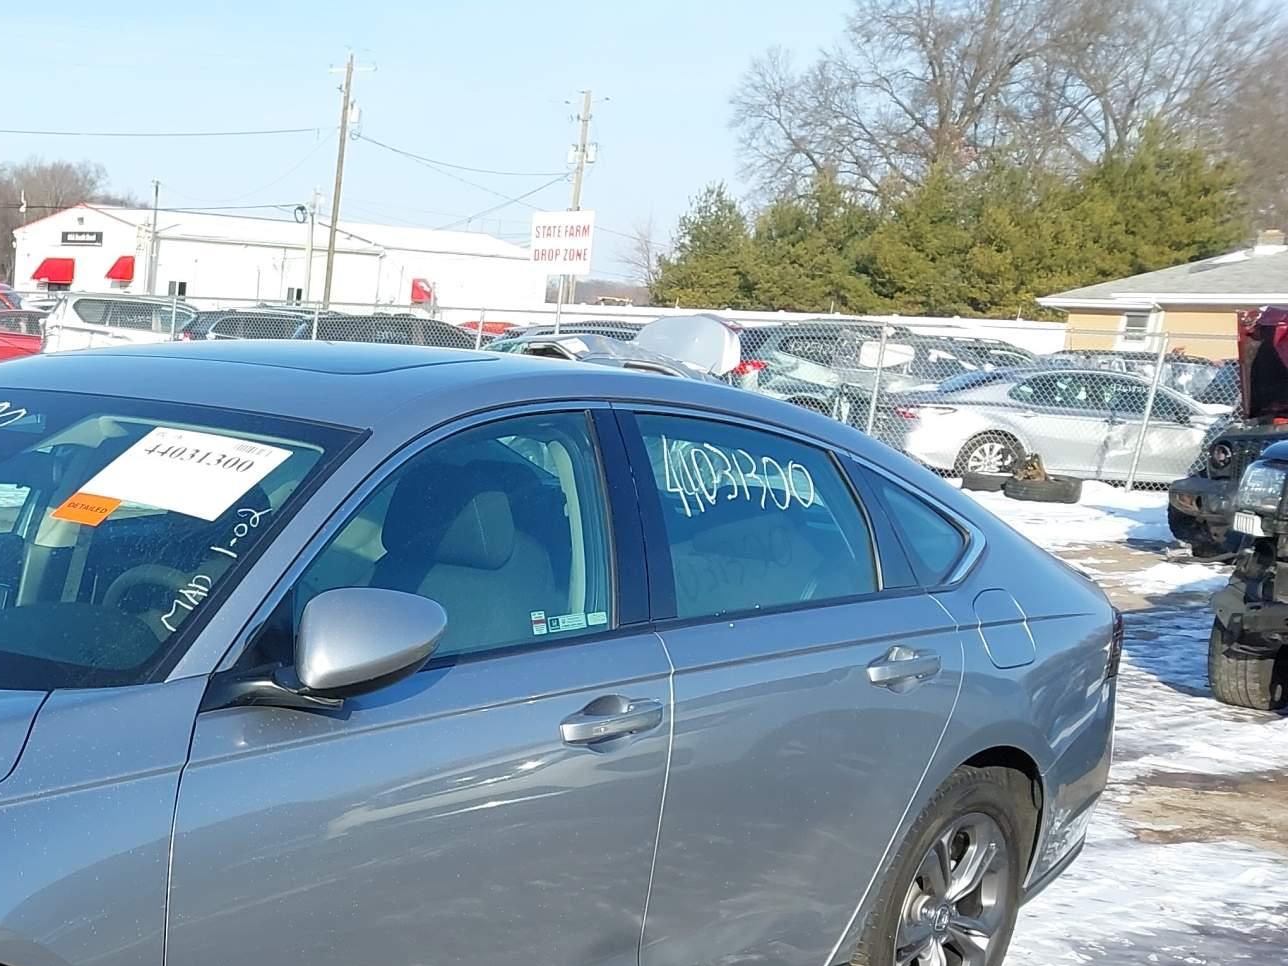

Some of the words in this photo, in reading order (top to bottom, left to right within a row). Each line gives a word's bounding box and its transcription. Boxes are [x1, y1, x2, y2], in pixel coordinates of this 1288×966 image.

[535, 225, 562, 239] STATE
[564, 223, 590, 239] FARM
[533, 248, 561, 262] DROP
[563, 247, 588, 262] ZONE
[144, 443, 255, 472] 44031300
[67, 502, 108, 514] DETAILED
